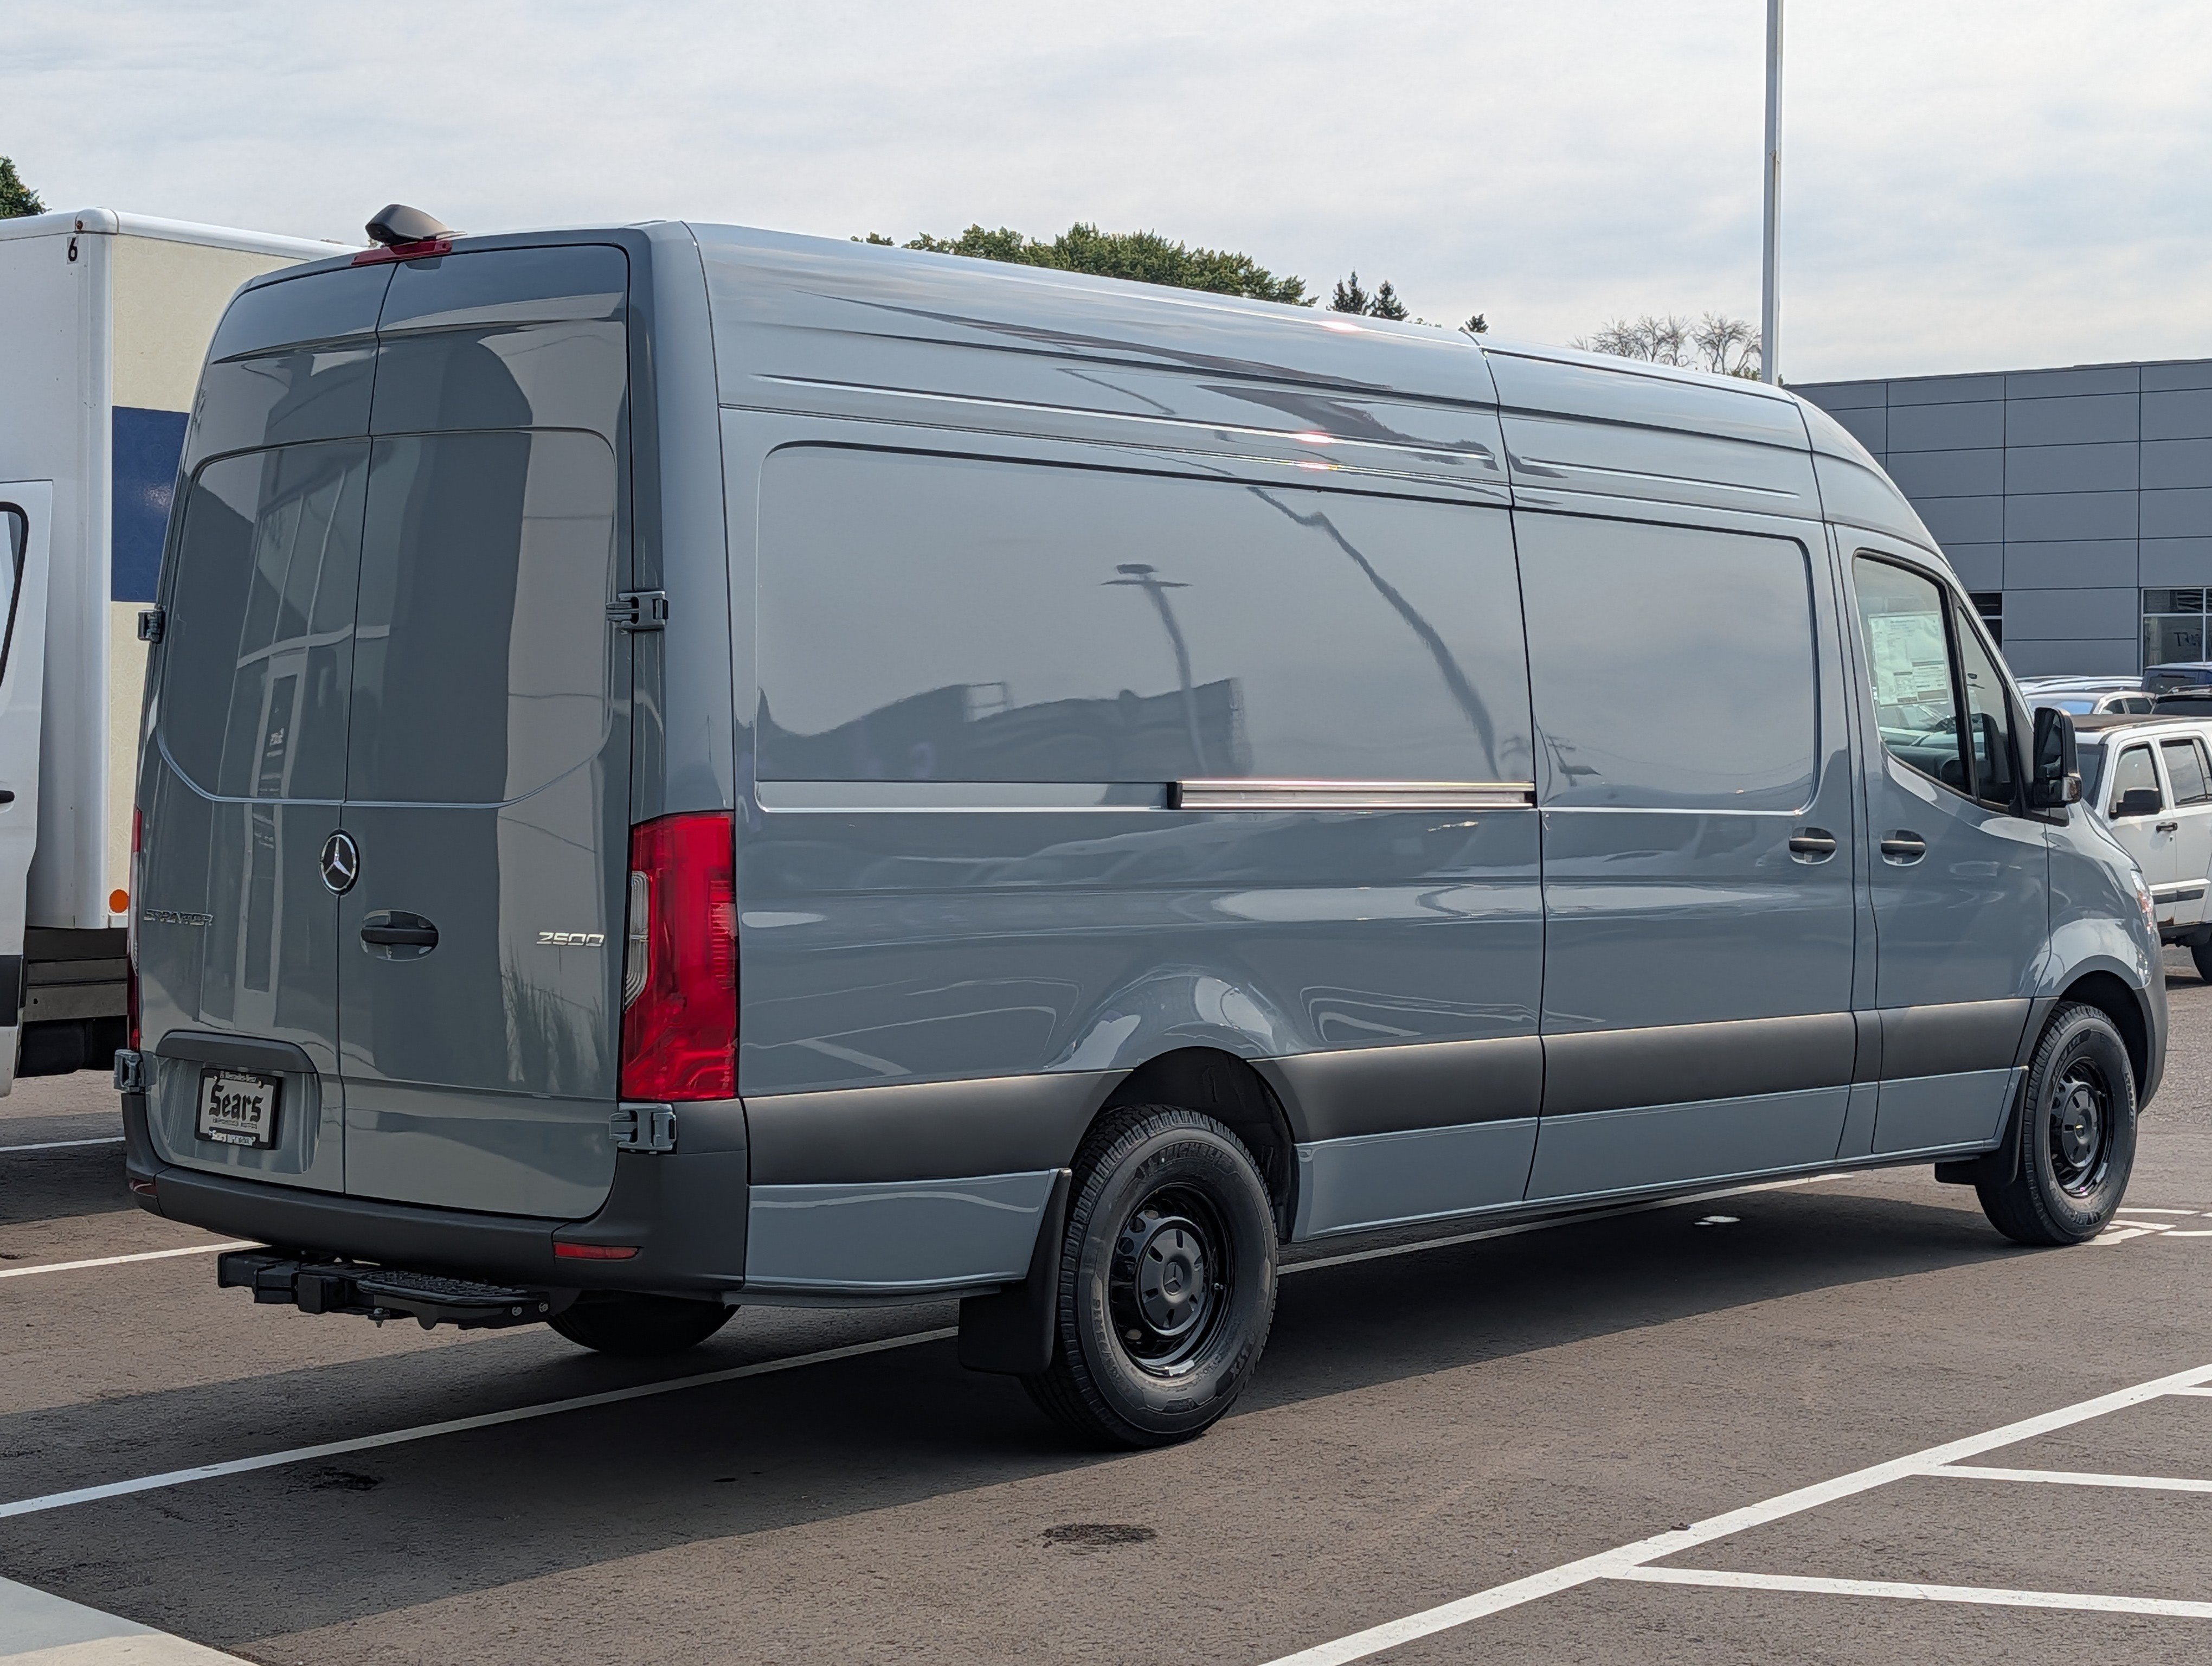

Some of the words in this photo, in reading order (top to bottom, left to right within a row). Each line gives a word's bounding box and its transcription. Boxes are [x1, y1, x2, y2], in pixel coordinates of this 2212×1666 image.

[176, 236, 187, 262] 6
[536, 932, 605, 947] 2500
[209, 1084, 263, 1123] Sears
